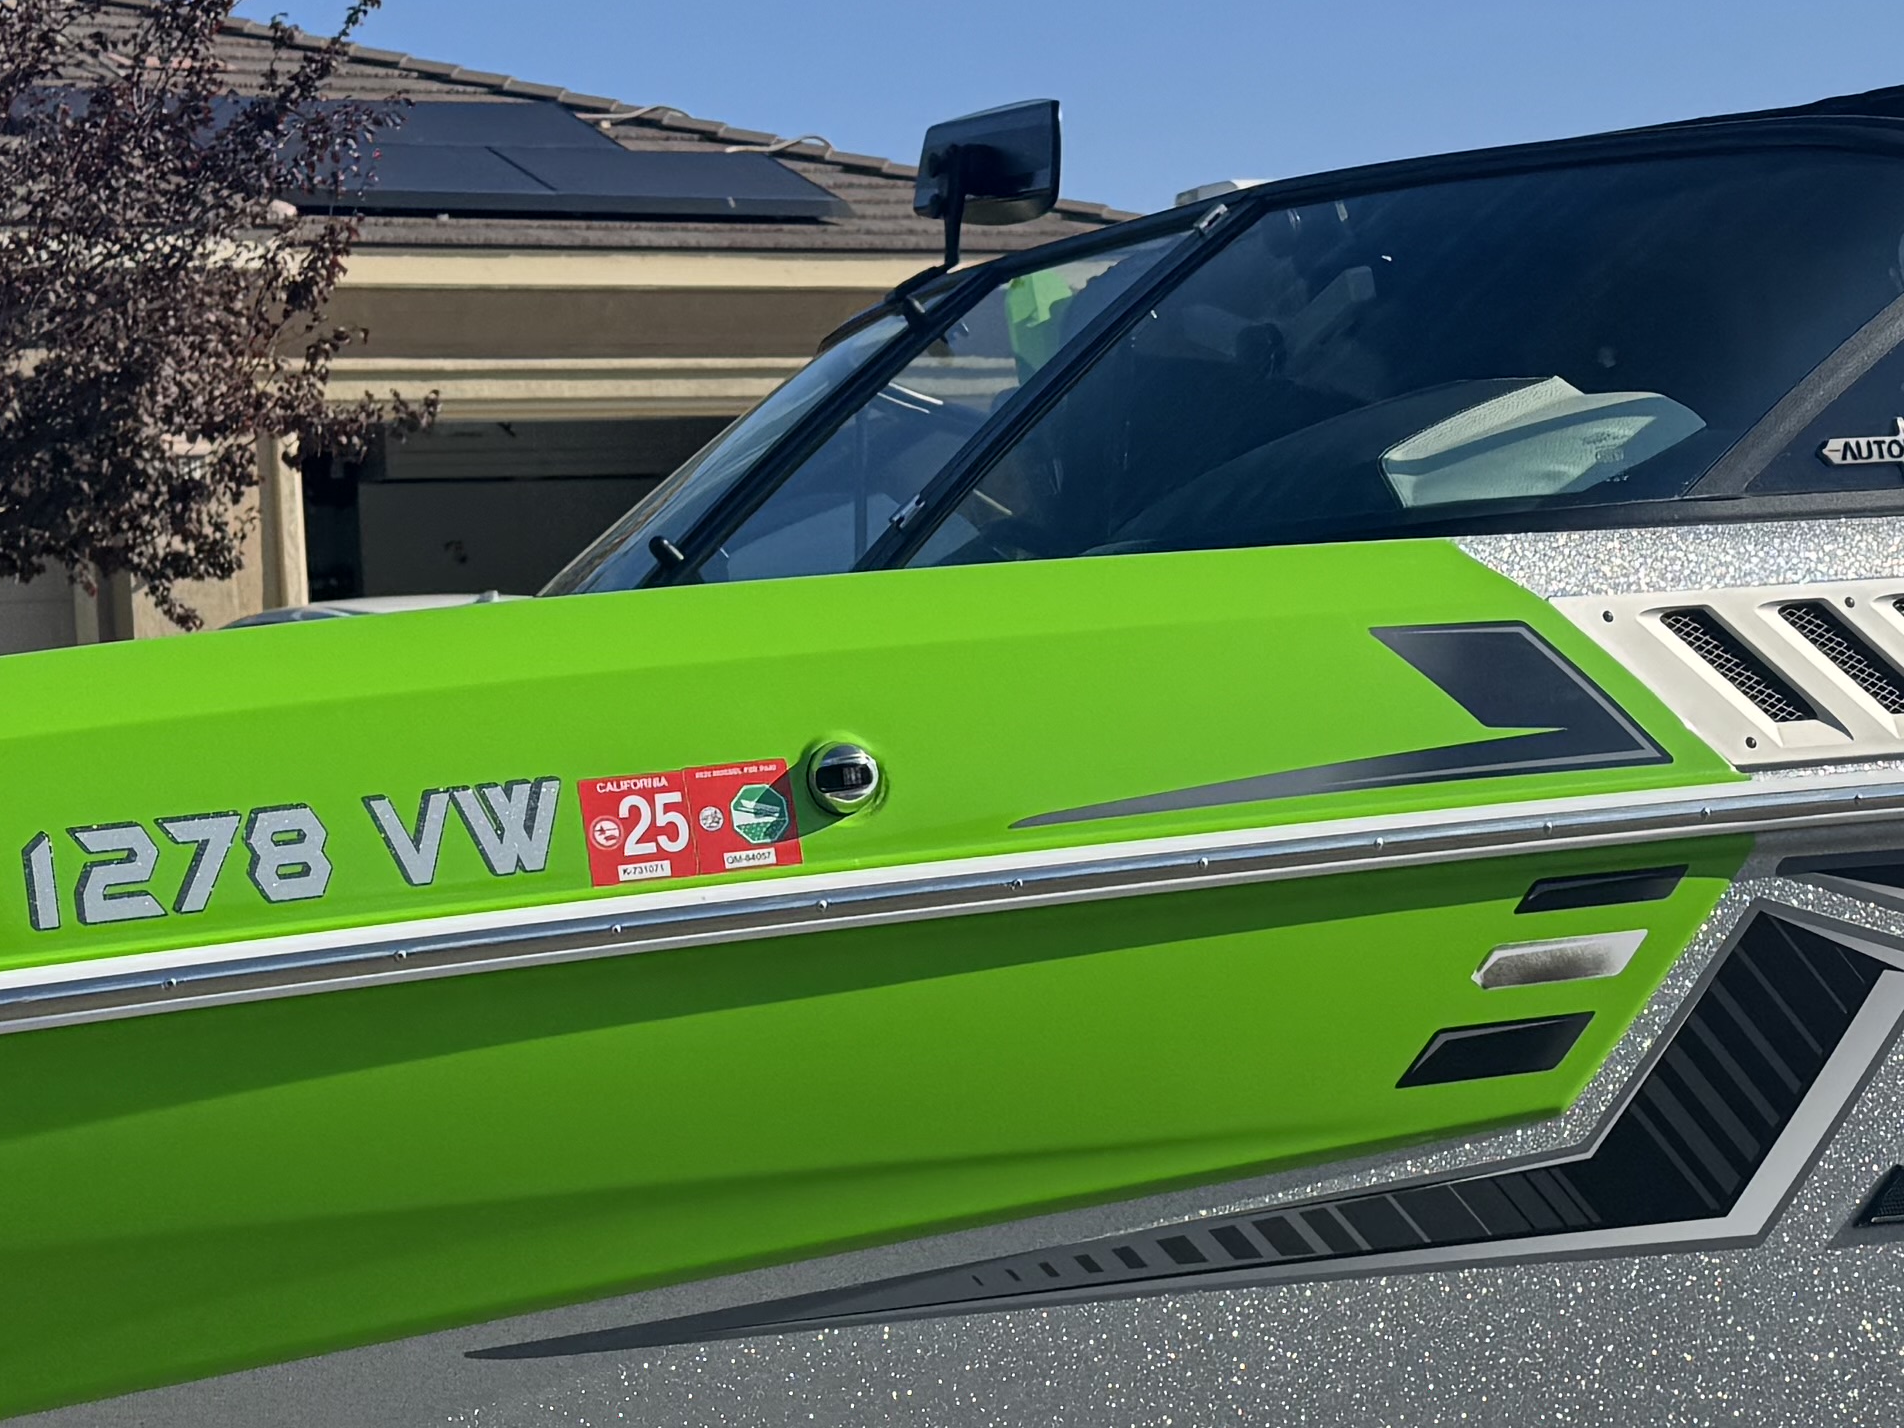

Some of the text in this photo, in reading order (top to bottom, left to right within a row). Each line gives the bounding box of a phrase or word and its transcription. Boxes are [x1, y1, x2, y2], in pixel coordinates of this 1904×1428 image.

[596, 775, 668, 794] CALIFORNIA
[22, 801, 334, 930] 1278
[362, 776, 560, 886] VW
[618, 791, 690, 857] 25
